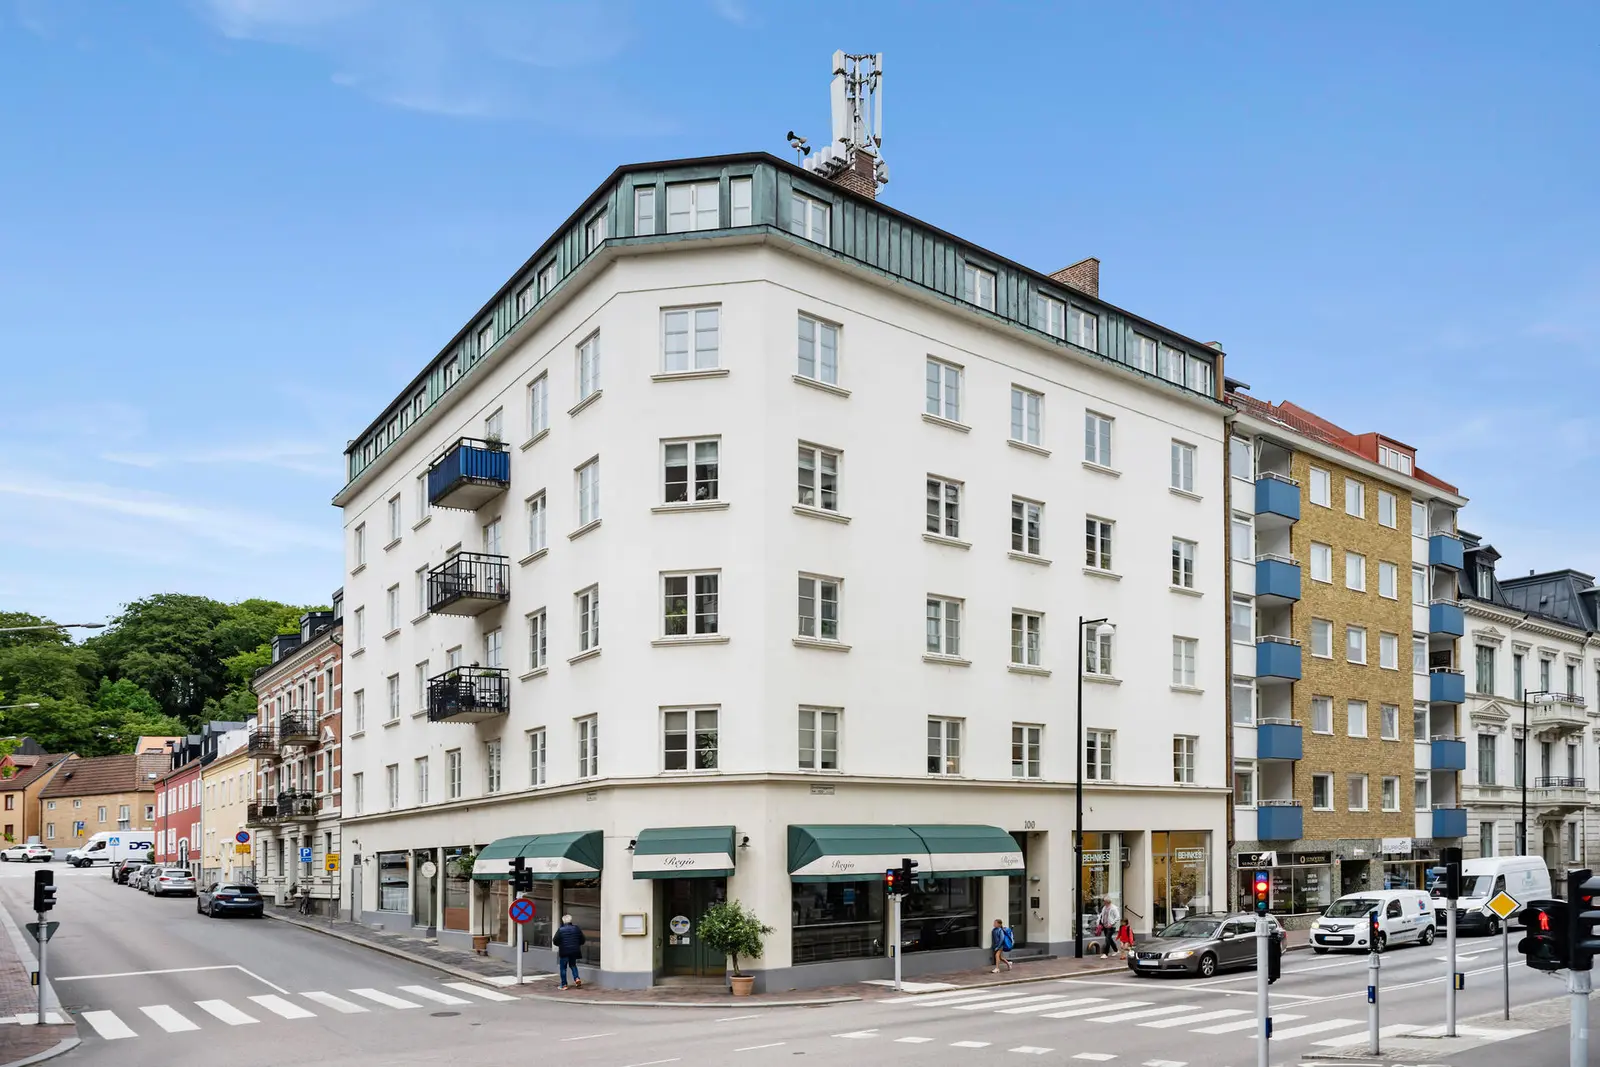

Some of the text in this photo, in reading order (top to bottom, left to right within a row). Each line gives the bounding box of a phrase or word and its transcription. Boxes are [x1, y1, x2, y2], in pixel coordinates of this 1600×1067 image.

[1024, 820, 1035, 829] 100
[663, 857, 696, 867] Regio
[831, 860, 855, 871] Regio
[1000, 855, 1019, 866] Regio
